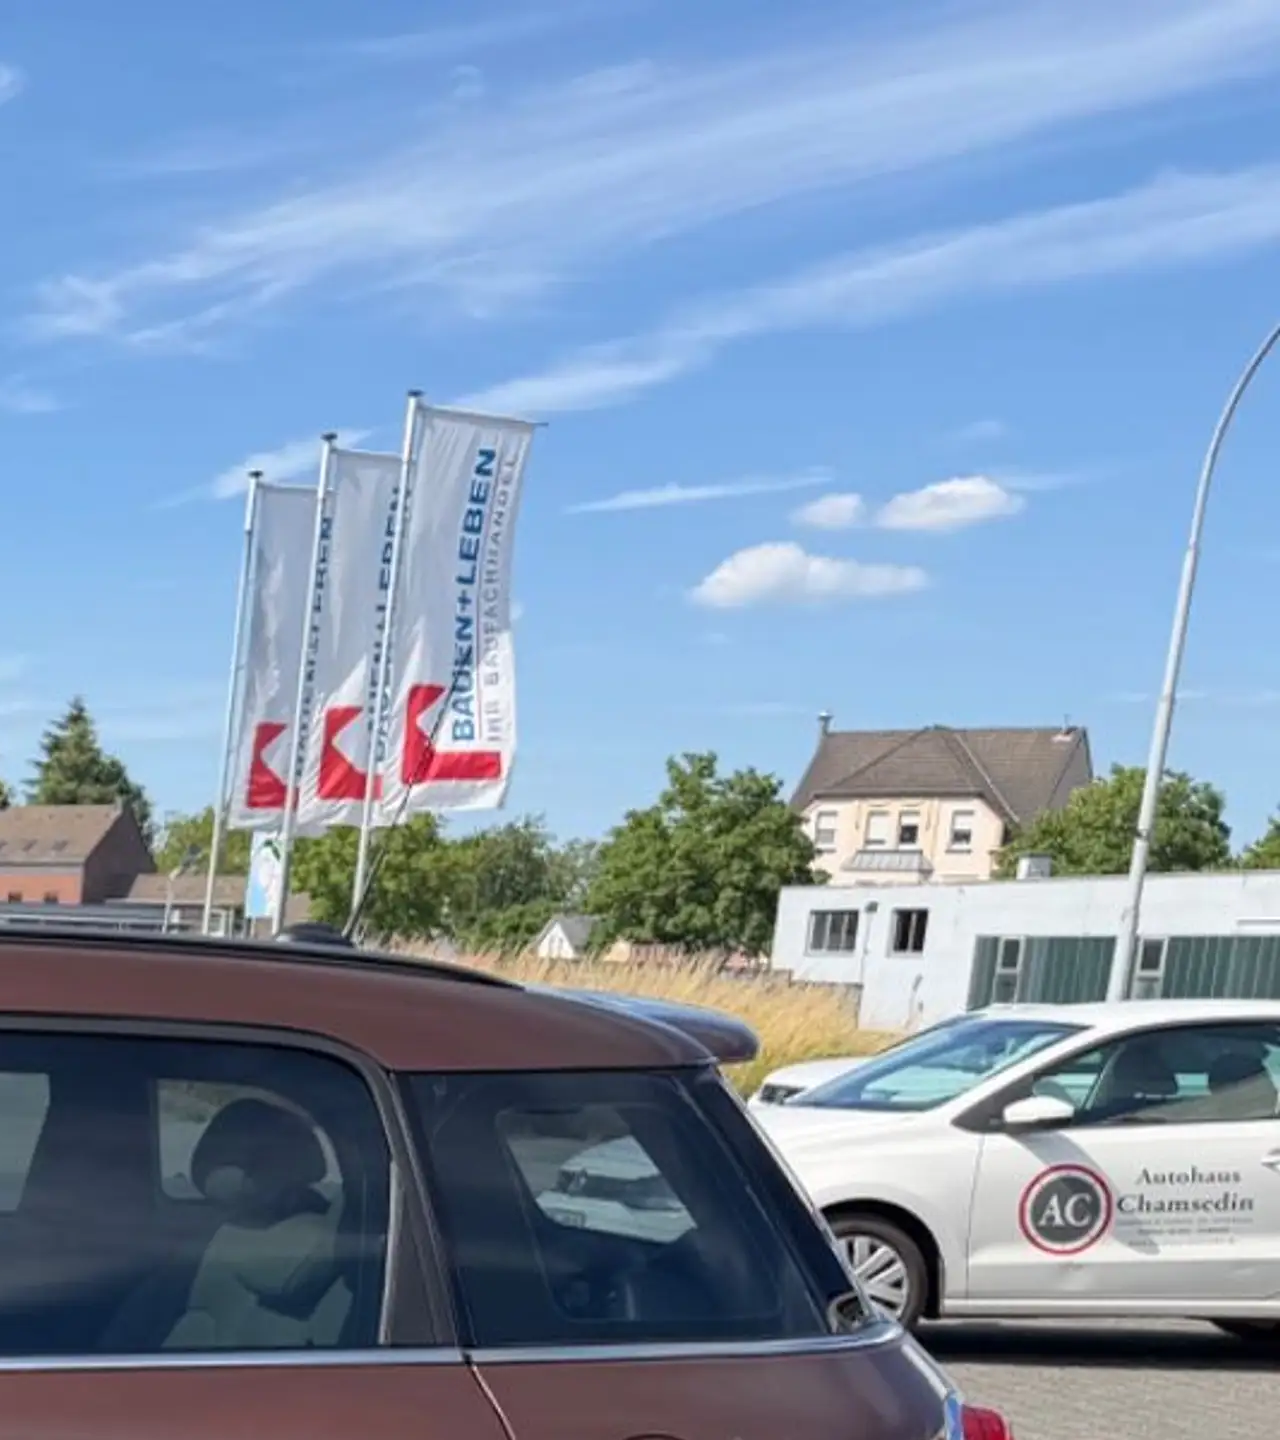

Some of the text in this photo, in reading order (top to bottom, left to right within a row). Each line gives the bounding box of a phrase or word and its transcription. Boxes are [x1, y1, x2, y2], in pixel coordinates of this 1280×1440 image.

[452, 448, 496, 741] BAUEN+LEBEN
[1136, 1165, 1241, 1185] Autohaus
[1038, 1192, 1093, 1228] AC
[1116, 1192, 1254, 1214] Chamsedin
